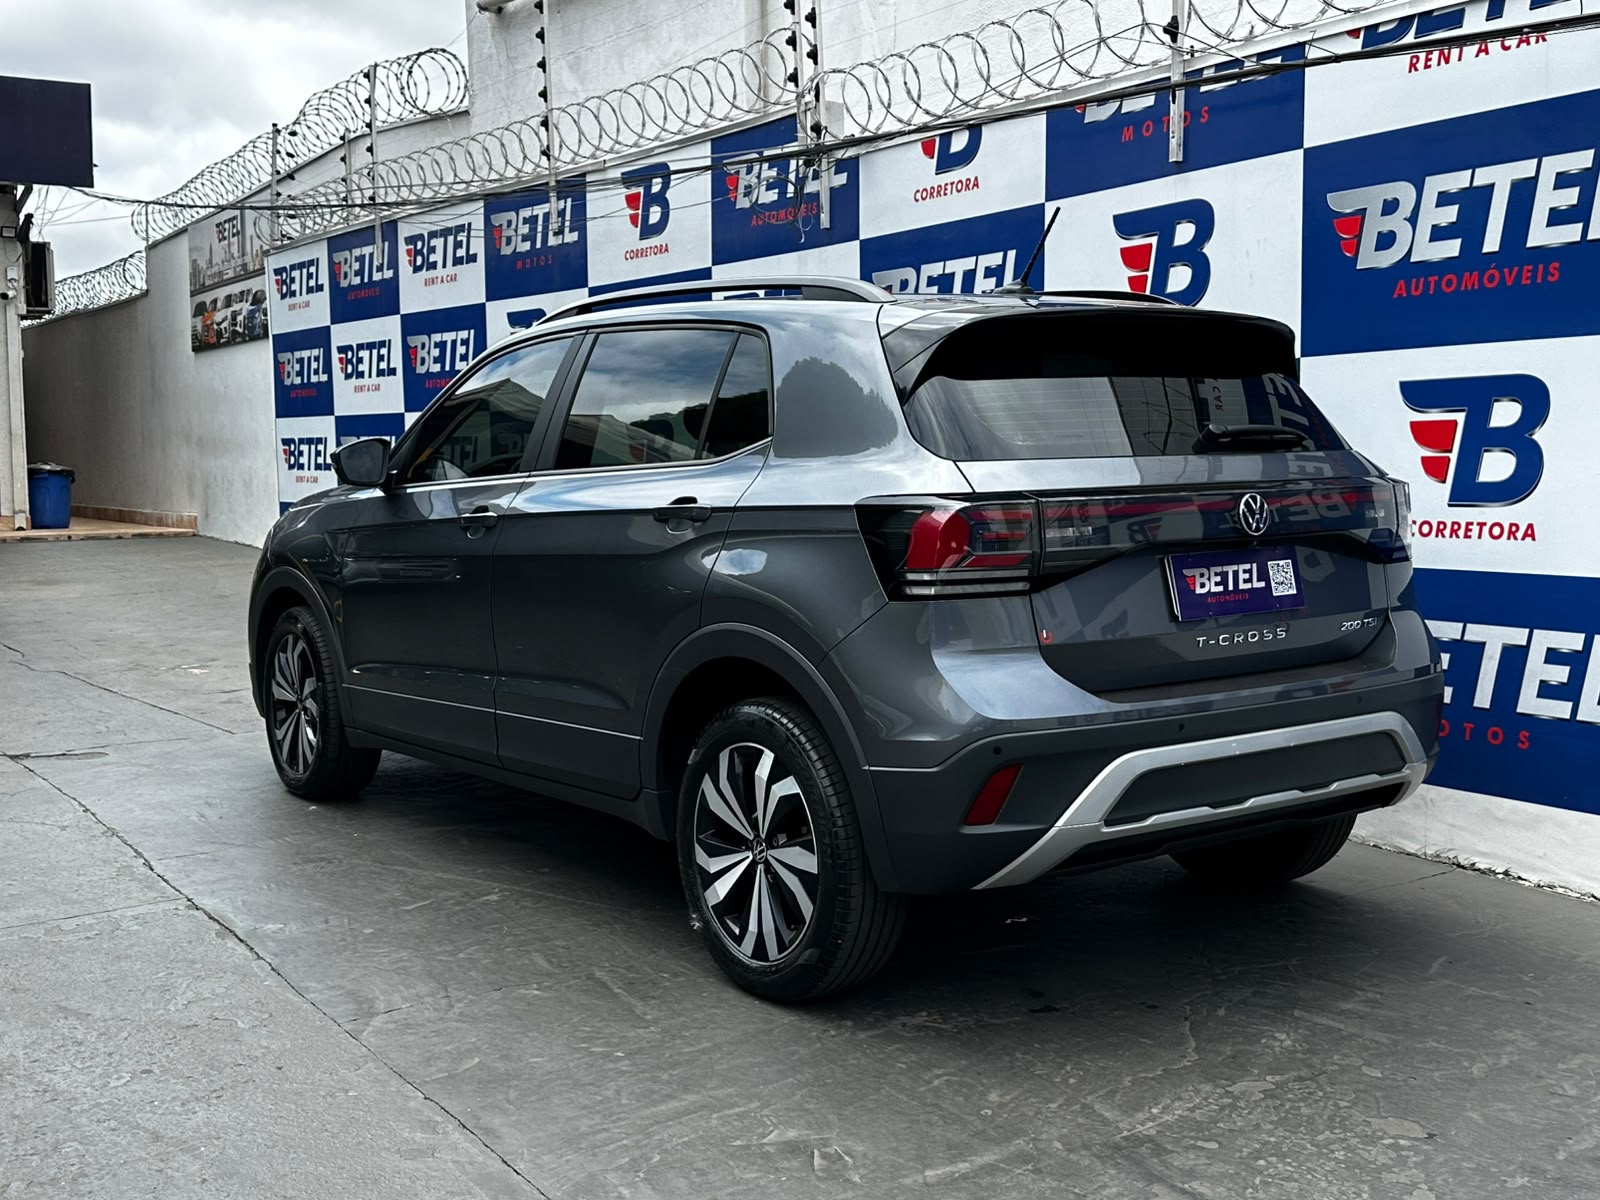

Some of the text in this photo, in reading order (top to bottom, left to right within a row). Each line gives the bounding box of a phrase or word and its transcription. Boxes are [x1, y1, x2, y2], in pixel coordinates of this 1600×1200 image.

[1408, 44, 1464, 73] RENT
[1475, 40, 1490, 58] A
[1122, 106, 1209, 142] MOTOS
[913, 176, 980, 202] CORRETORA
[490, 197, 579, 255] BETEL
[1327, 149, 1600, 270] BETE
[215, 215, 241, 243] BETEL
[332, 241, 394, 288] BETEL
[404, 222, 478, 274] BETEL
[516, 254, 552, 270] MOTOS
[624, 243, 669, 261] CORRETORA
[273, 257, 324, 300] BETEL
[424, 276, 439, 287] RENT
[446, 273, 457, 283] CAR
[1393, 262, 1560, 298] AUTOMÓVEIS
[278, 347, 328, 386] BETEL
[336, 339, 397, 380] BETEL
[407, 329, 475, 374] BETEL
[354, 385, 366, 393] RENT
[281, 437, 332, 471] BETEL
[1182, 563, 1266, 594] BETEL
[1207, 593, 1249, 603] AUTOMÓVEIS
[1196, 627, 1287, 648] T-CROSS
[1340, 620, 1361, 631] 200
[1437, 719, 1530, 750] OTOS
